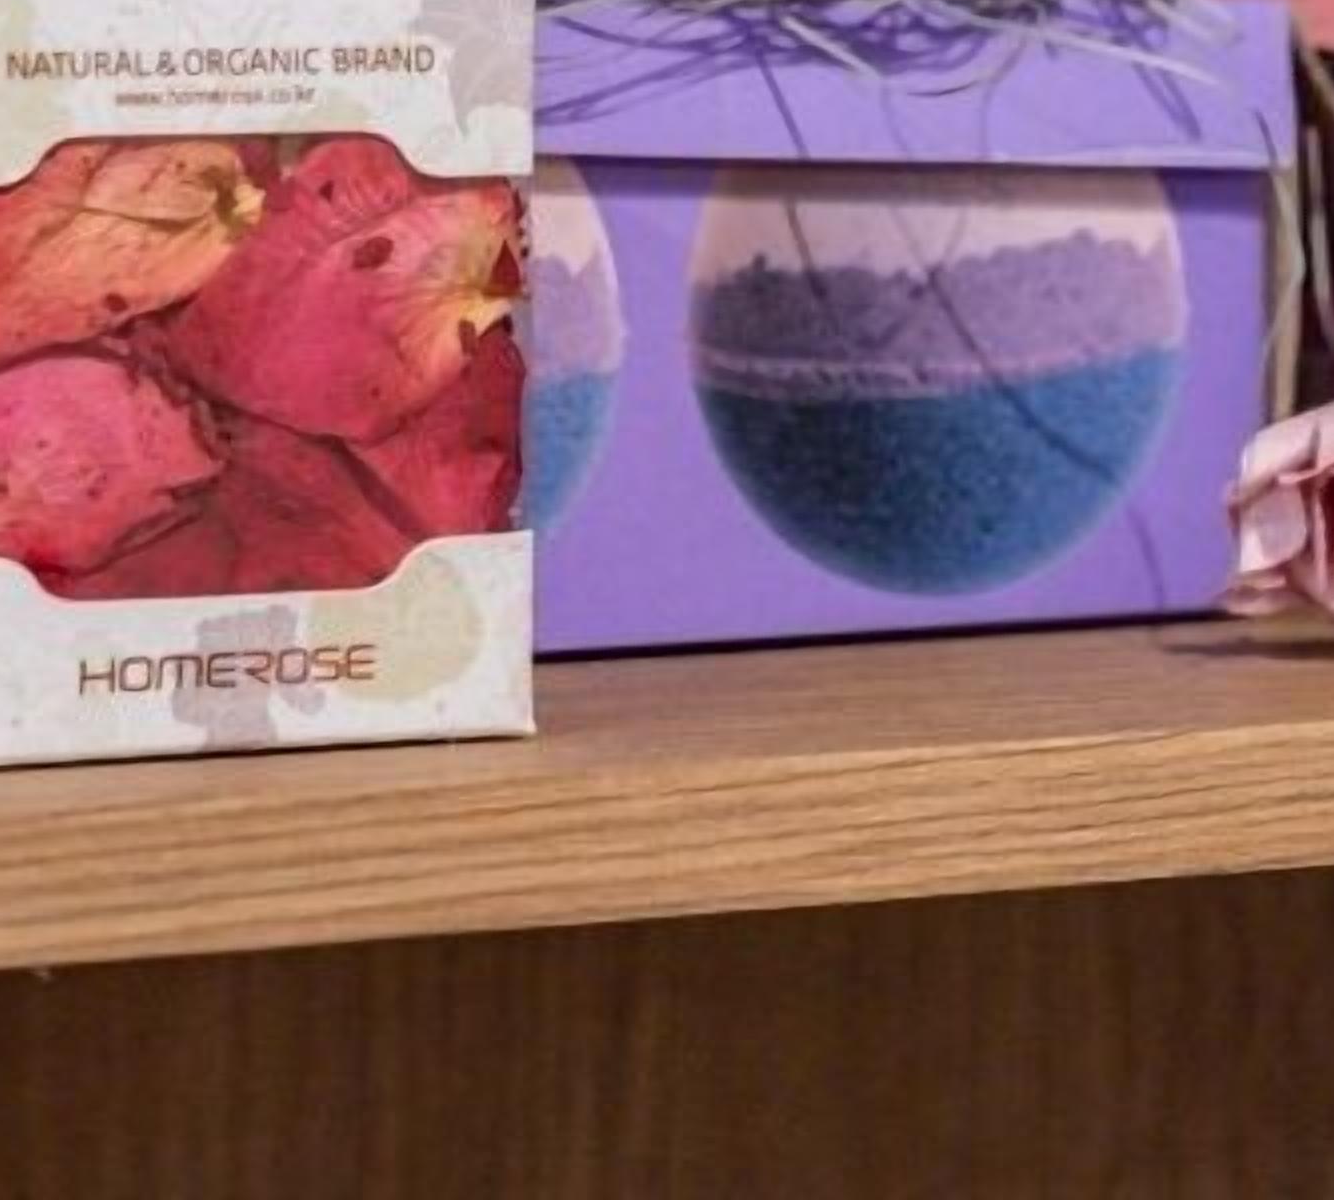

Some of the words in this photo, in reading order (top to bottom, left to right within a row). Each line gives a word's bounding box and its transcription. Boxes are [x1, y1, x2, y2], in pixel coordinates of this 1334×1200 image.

[6, 49, 157, 80] NATURAL
[183, 46, 321, 78] ORGANIC
[331, 43, 436, 75] BRAND
[78, 643, 376, 696] HOMEROSE
